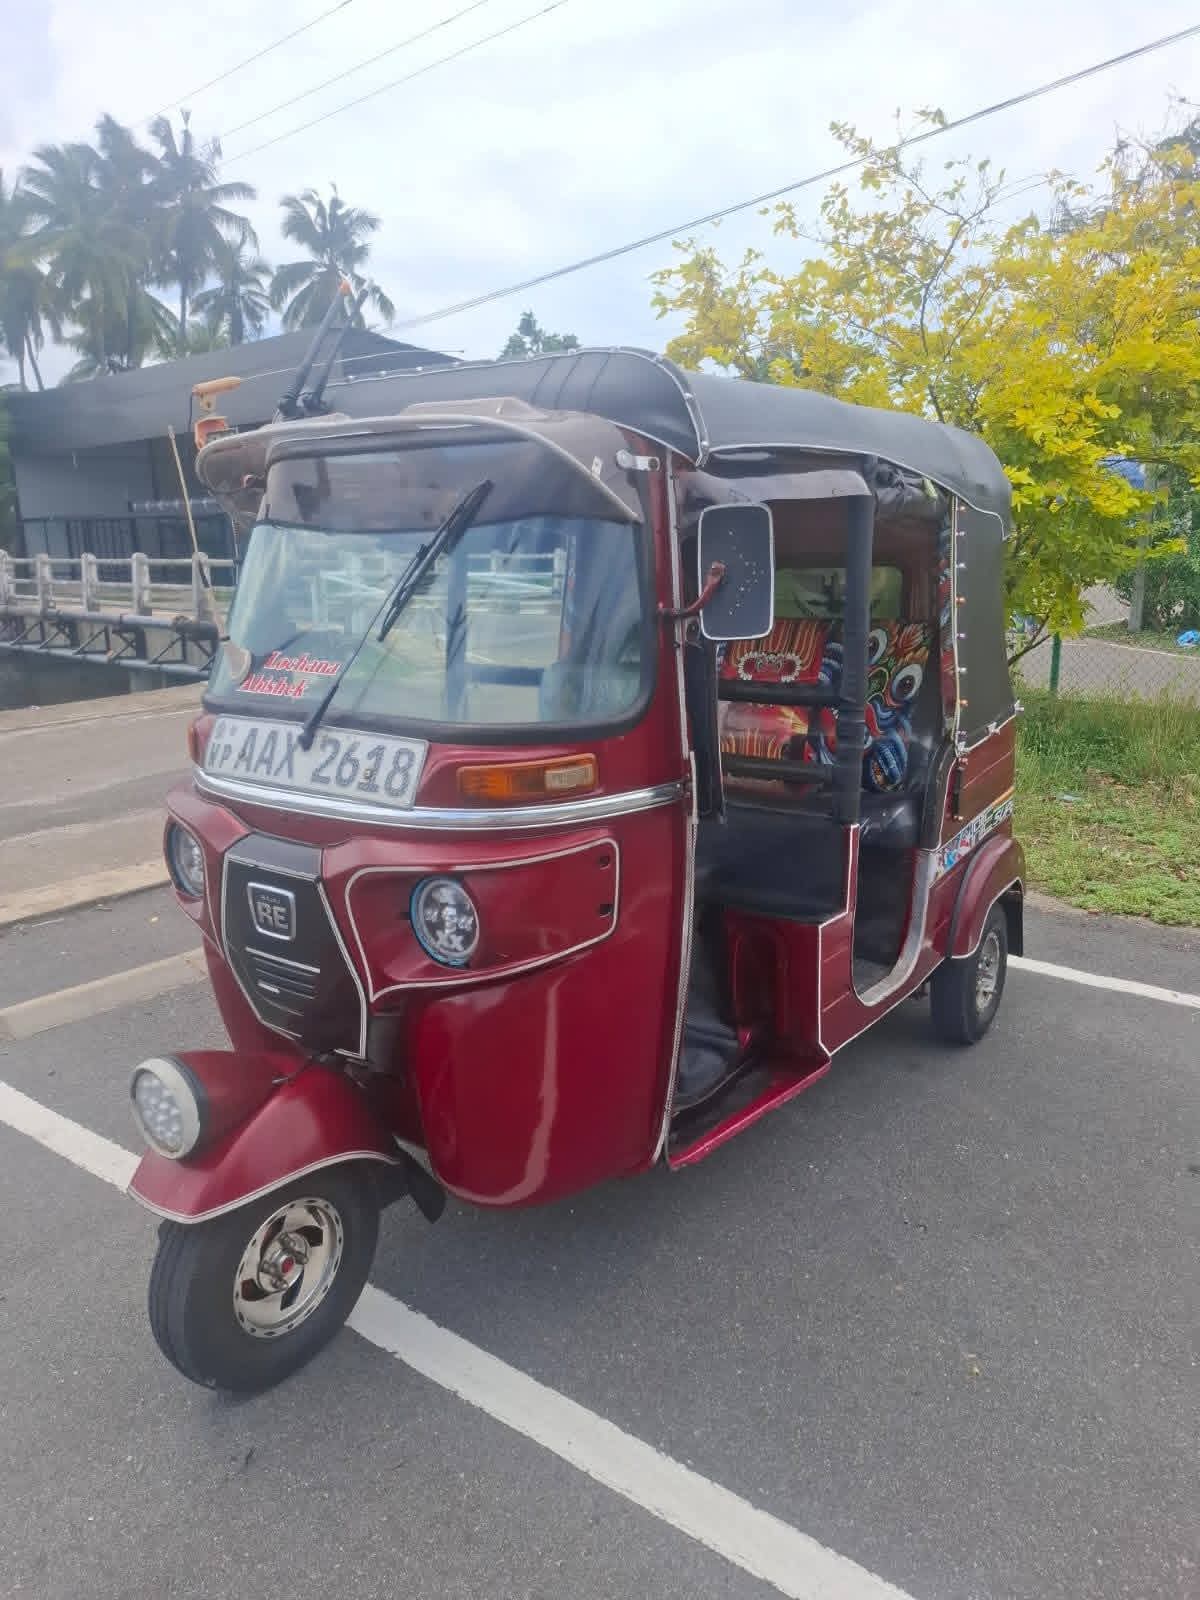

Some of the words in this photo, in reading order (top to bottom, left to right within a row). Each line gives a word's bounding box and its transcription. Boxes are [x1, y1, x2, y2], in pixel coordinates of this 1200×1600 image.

[233, 727, 304, 779] AAX
[311, 736, 416, 797] 2618
[256, 901, 289, 930] RE
